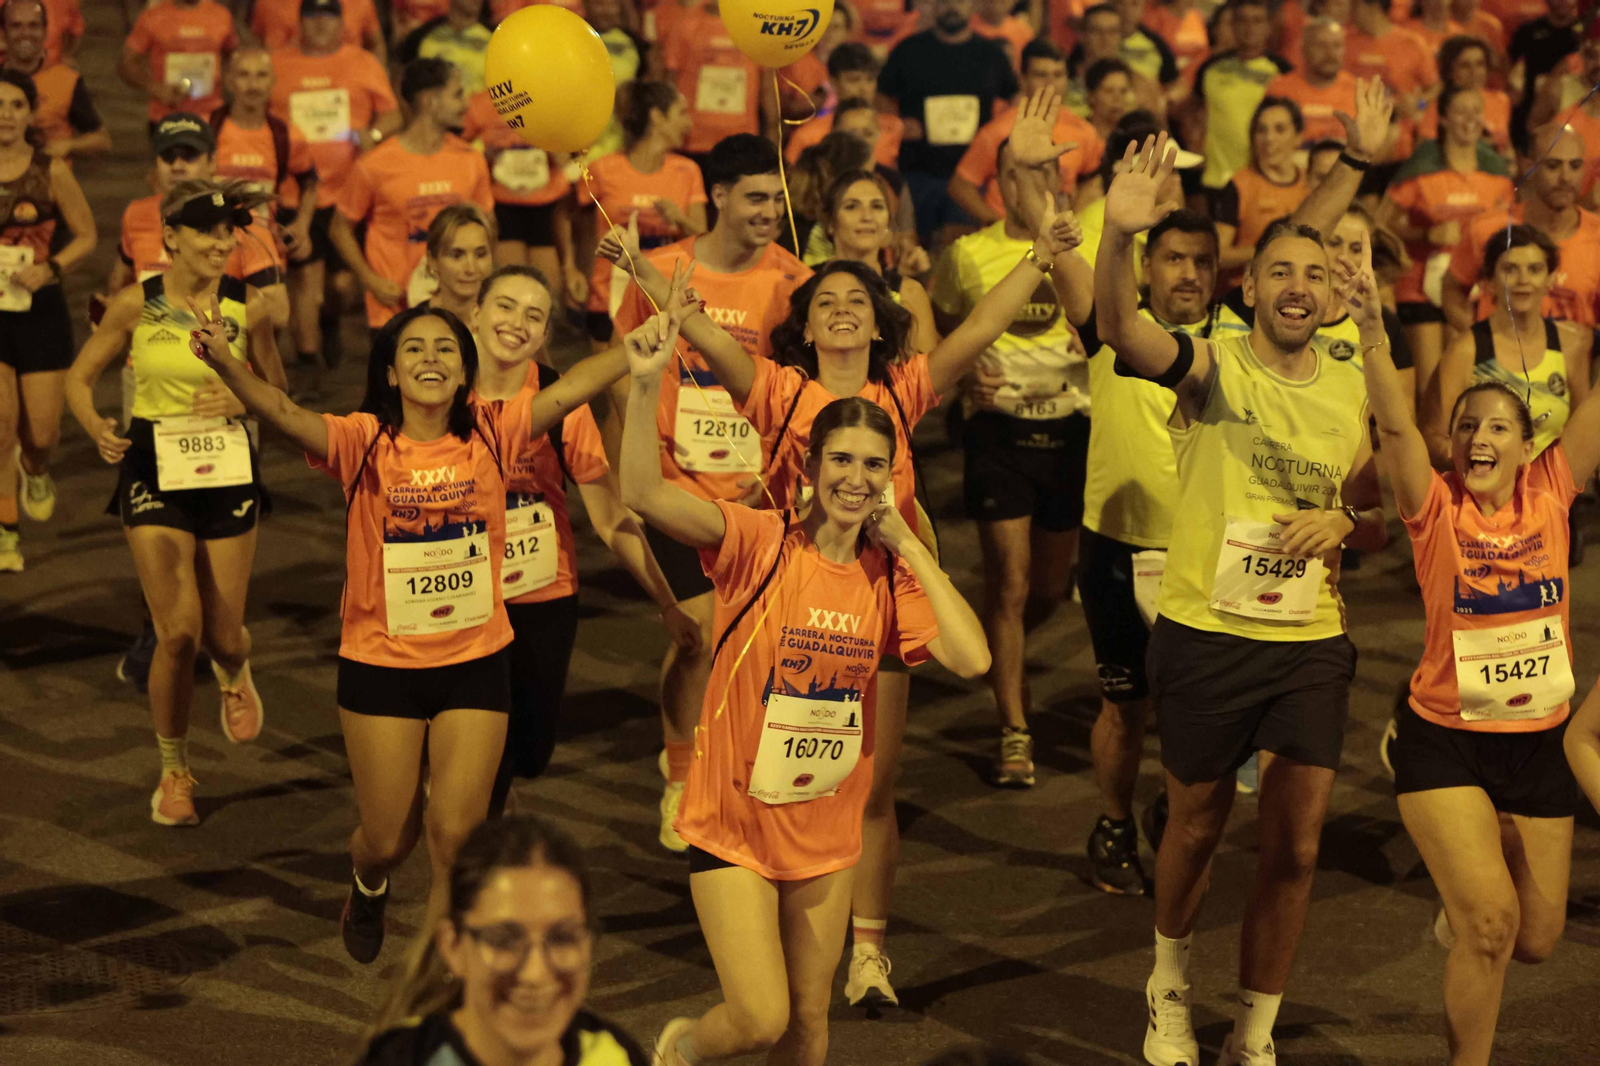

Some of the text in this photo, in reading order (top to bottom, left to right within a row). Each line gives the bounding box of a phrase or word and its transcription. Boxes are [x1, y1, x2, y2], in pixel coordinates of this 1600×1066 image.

[753, 12, 795, 21] NOCTURNA
[693, 418, 750, 438] 12810
[178, 435, 226, 454] 9883
[410, 465, 457, 487] XXXV
[1251, 453, 1343, 480] NOCTURNA
[387, 478, 476, 495] CARRERA NOCTURNA
[392, 486, 475, 504] GUADALQUIVIR
[1245, 492, 1267, 502] GRAN
[504, 536, 540, 560] 812
[1460, 541, 1499, 549] CARRERA
[1242, 554, 1307, 579] 15429
[406, 570, 473, 595] 12809
[806, 607, 861, 634] XXXV
[781, 626, 875, 648] CARRERA NOCTURNA
[787, 637, 875, 660] GUADALQUIVIR
[1480, 655, 1550, 684] 15427
[783, 737, 844, 761] 16070
